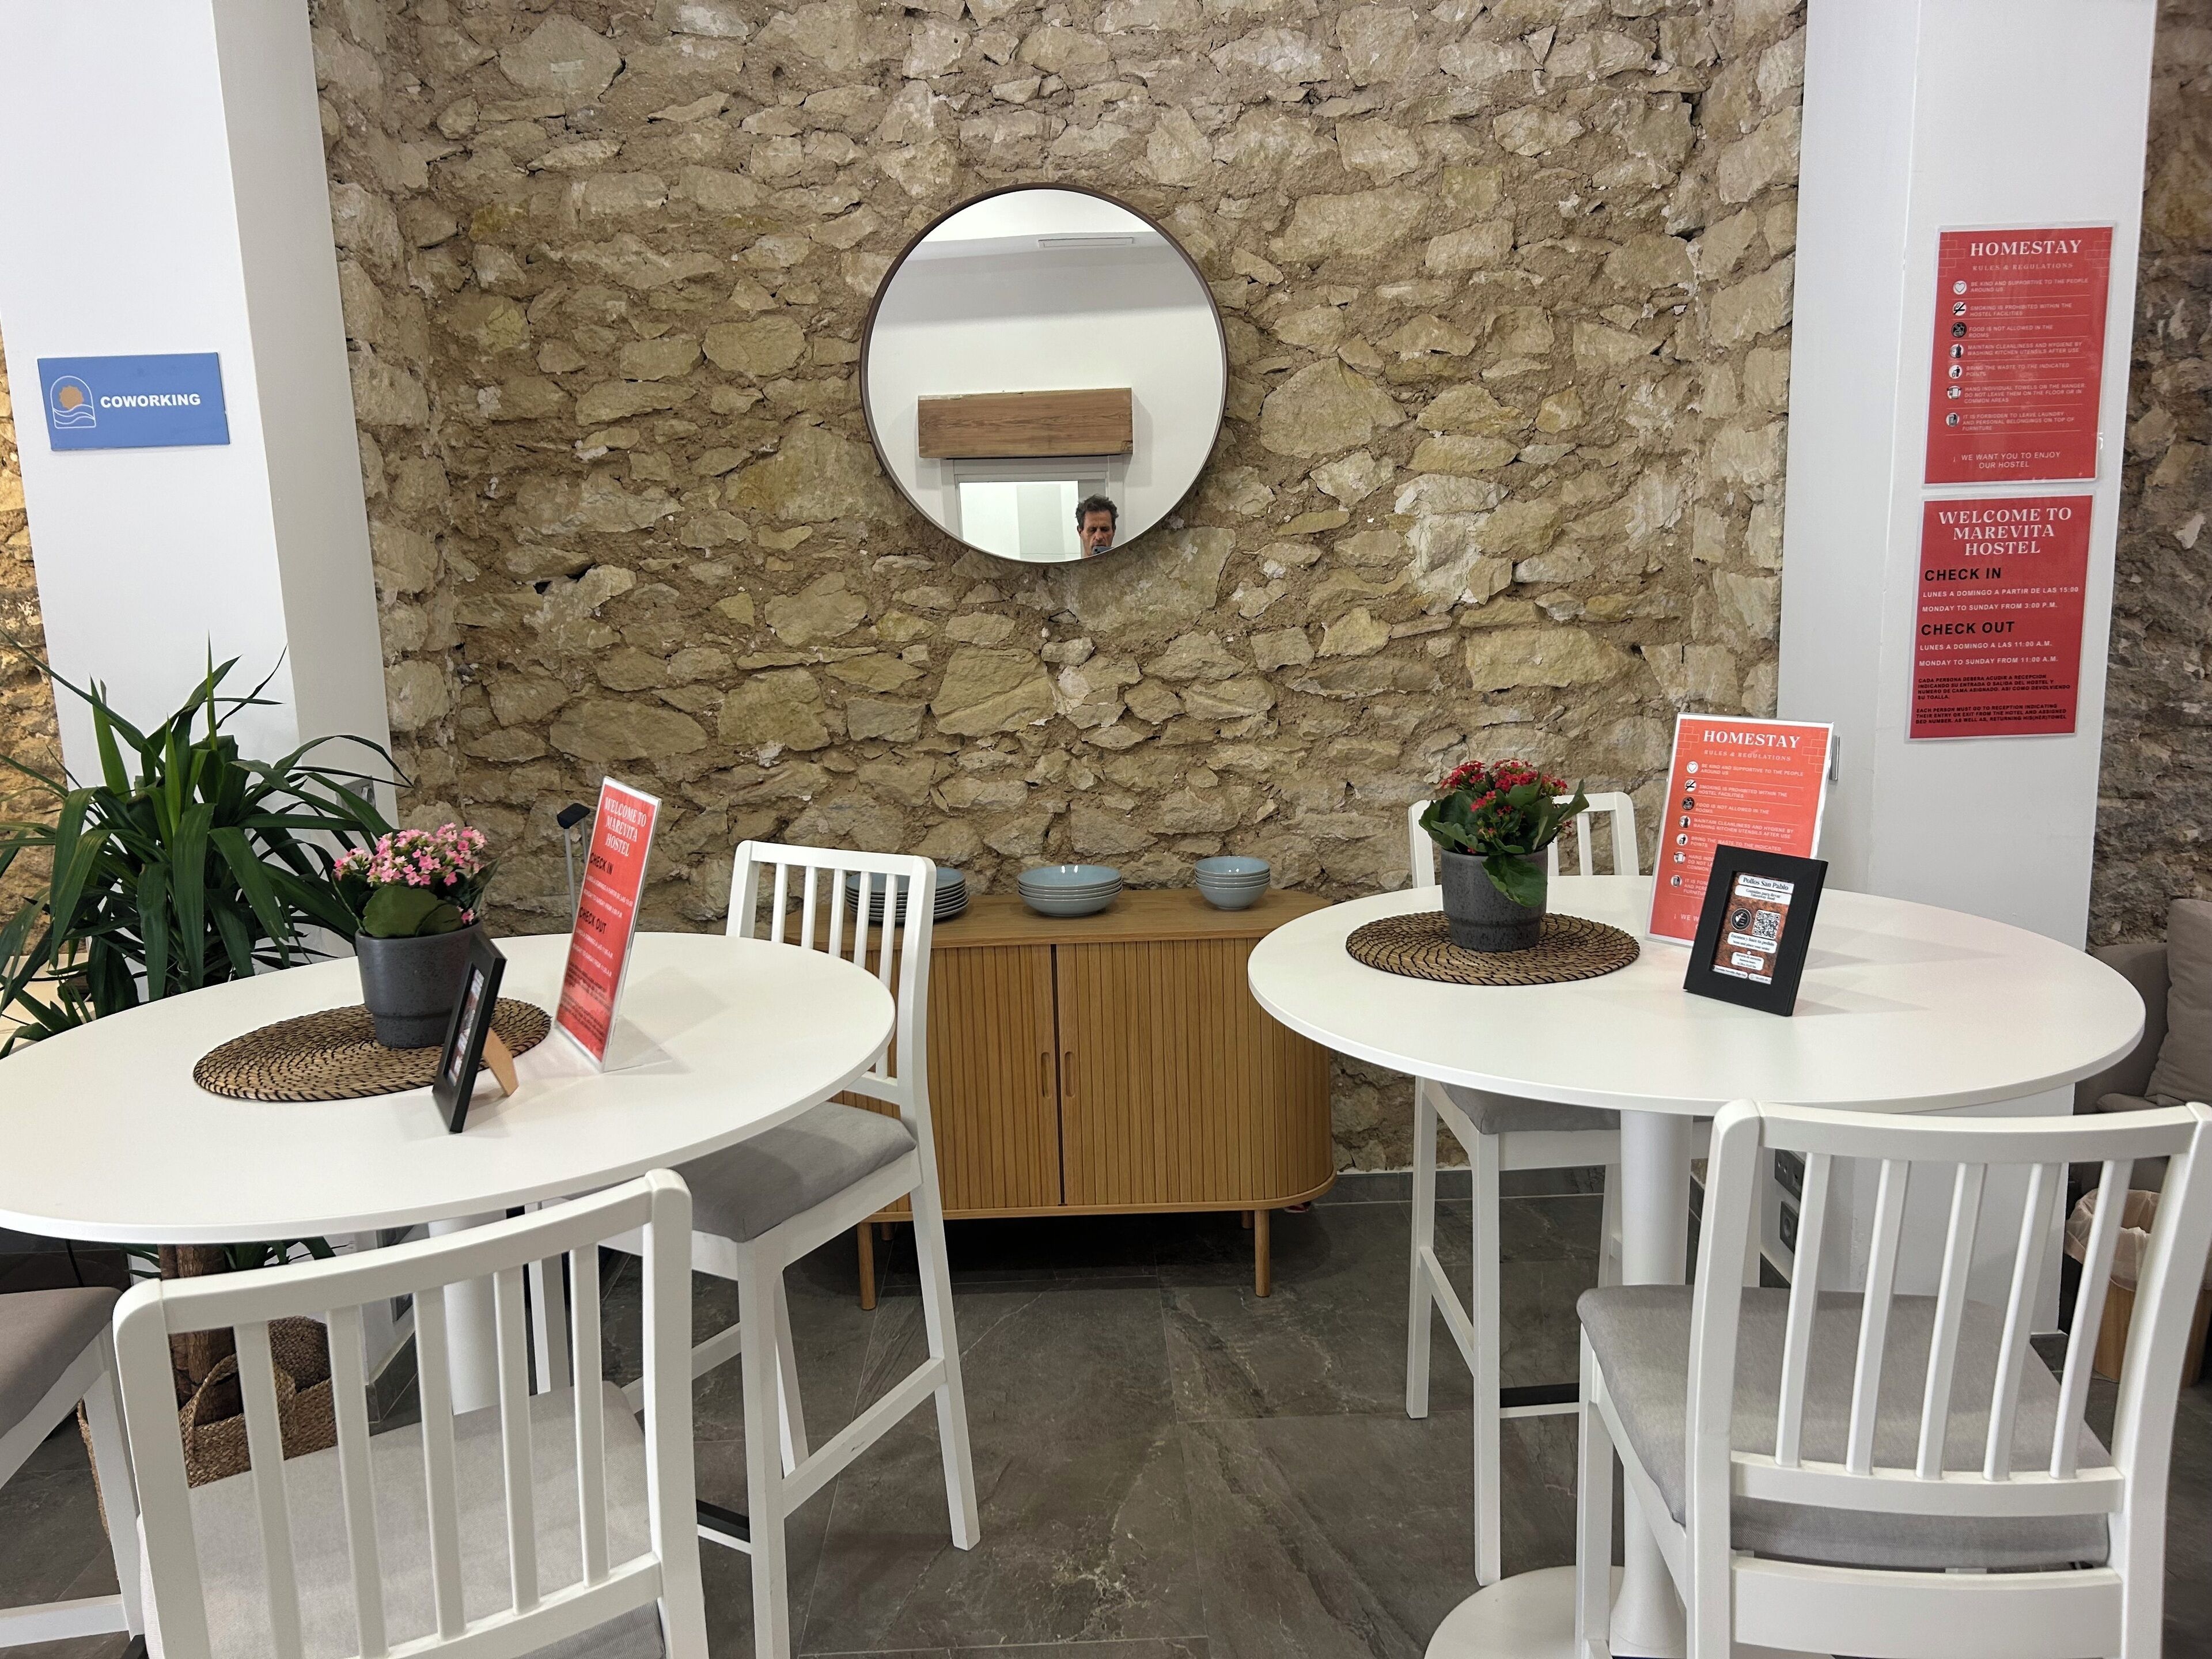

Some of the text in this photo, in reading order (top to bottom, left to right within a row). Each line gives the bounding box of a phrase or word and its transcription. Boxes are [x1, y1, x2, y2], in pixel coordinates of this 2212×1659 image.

[1971, 240, 2082, 256] HOMESTAY
[100, 393, 200, 408] COWORKING
[1939, 507, 2071, 524] WELCOME TO
[1953, 524, 2055, 540] MAREVITA
[1964, 541, 2040, 556] HOSTEL
[1925, 567, 2002, 581] CHECK IN
[1921, 621, 2015, 635] CHECK OUT
[1703, 730, 1800, 748] HOMESTAY
[1738, 752, 1791, 761] REGULATIONS
[605, 797, 647, 827] WELCOME TO
[606, 815, 638, 842] MAREVITA
[606, 833, 630, 857] HOSTEL
[590, 853, 613, 875] CHECK IN
[1772, 882, 1789, 891] Pablo
[580, 906, 607, 934] CHECK OUT
